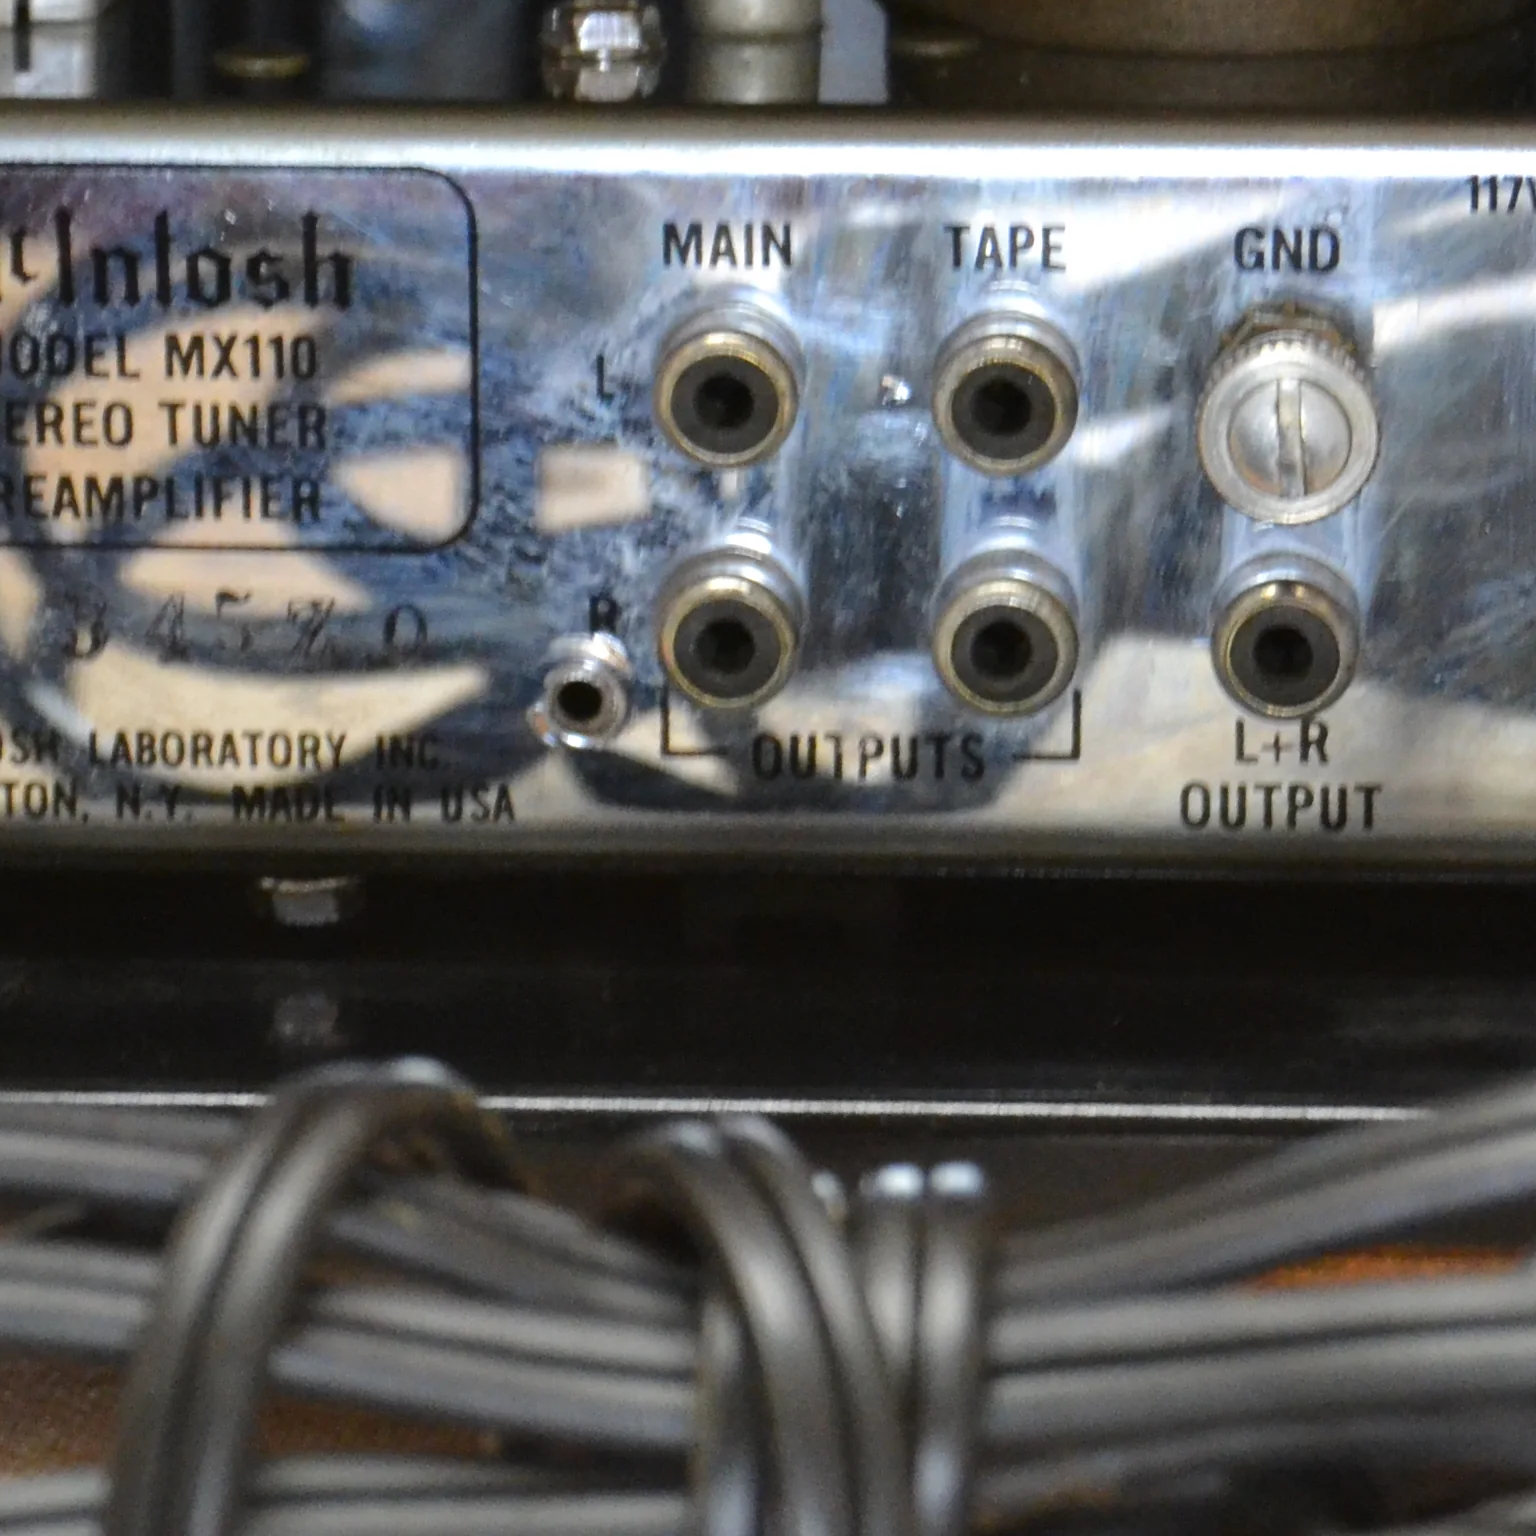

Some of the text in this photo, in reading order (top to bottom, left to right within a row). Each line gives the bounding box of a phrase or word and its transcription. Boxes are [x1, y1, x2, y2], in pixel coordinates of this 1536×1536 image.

[663, 222, 794, 267] MAIN
[945, 225, 1068, 270] TAPE
[1233, 227, 1342, 272] GND
[164, 334, 318, 381] MX110
[158, 402, 328, 451] TUNER
[89, 730, 347, 771] LABORATORY
[750, 732, 987, 784] OUTPUTS
[1235, 720, 1330, 765] L+R
[232, 786, 346, 824] MADE
[372, 786, 412, 826] IN
[440, 786, 517, 827] USA
[1180, 782, 1383, 832] OUTPUT
